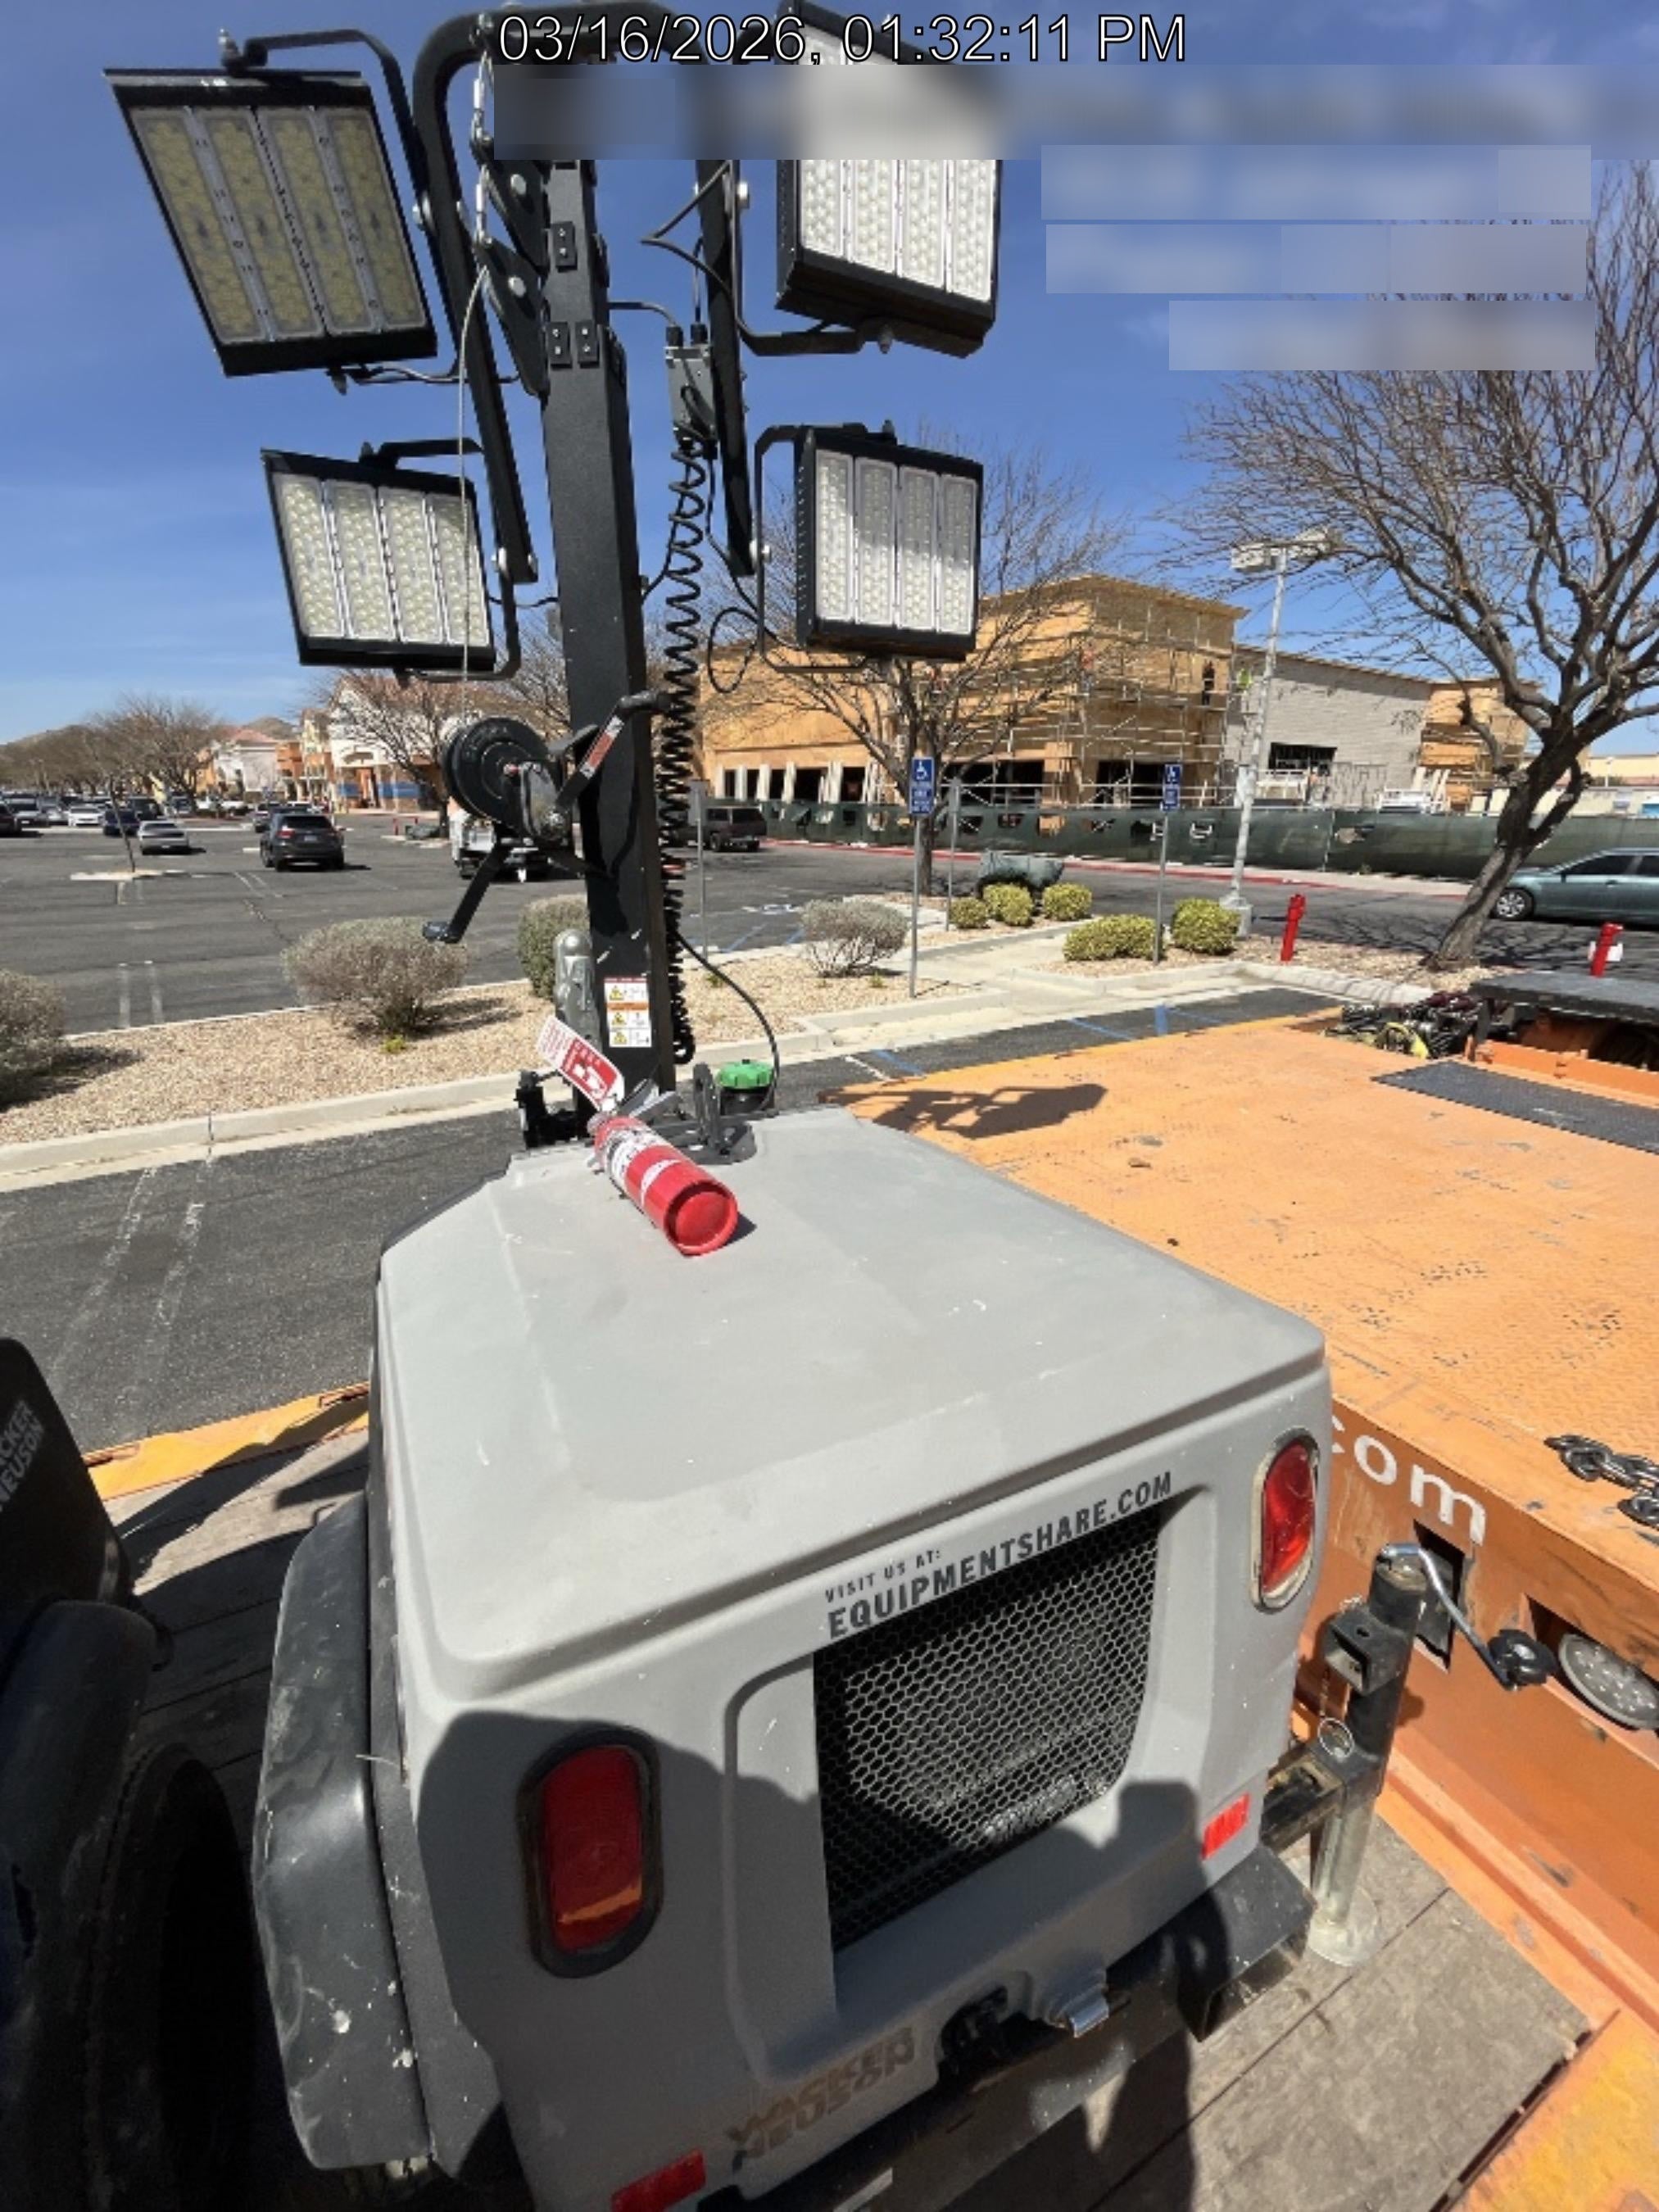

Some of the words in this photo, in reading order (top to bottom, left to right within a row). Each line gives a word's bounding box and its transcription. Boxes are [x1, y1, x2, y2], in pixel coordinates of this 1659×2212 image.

[825, 1572, 875, 1603] VISIT
[884, 1562, 906, 1580] US
[916, 1548, 941, 1569] AT:
[827, 1471, 1172, 1639] EQUIPMENTSHARE.COM
